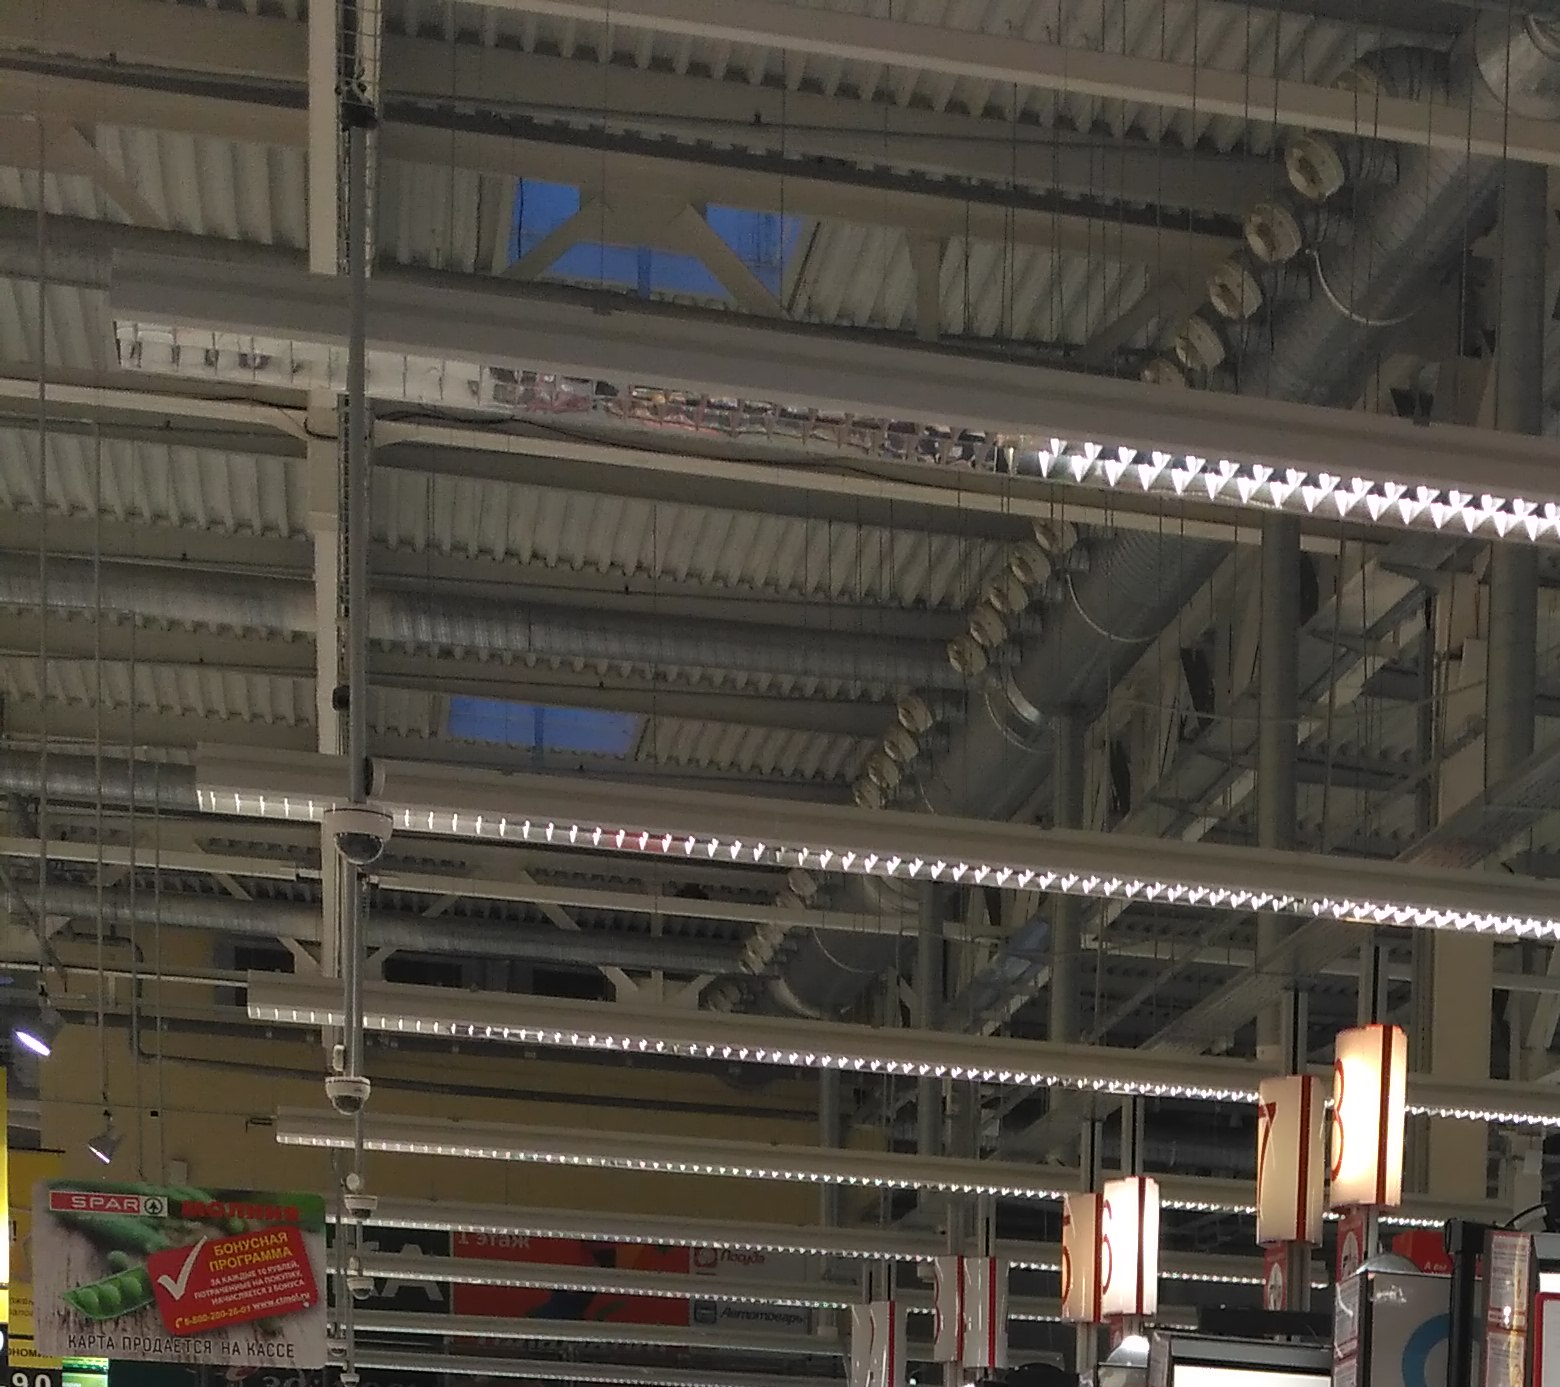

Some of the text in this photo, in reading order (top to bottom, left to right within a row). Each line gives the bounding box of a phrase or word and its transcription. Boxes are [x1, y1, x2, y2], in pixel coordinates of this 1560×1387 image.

[71, 1196, 140, 1211] SPAR
[213, 1231, 288, 1257] БОНУСНАЯ
[208, 1246, 293, 1273] ПРОГРАММА
[210, 1276, 221, 1287] ЗА
[68, 1334, 115, 1350] КАРТА
[221, 1339, 241, 1356] НА
[247, 1343, 295, 1358] КАССЕ
